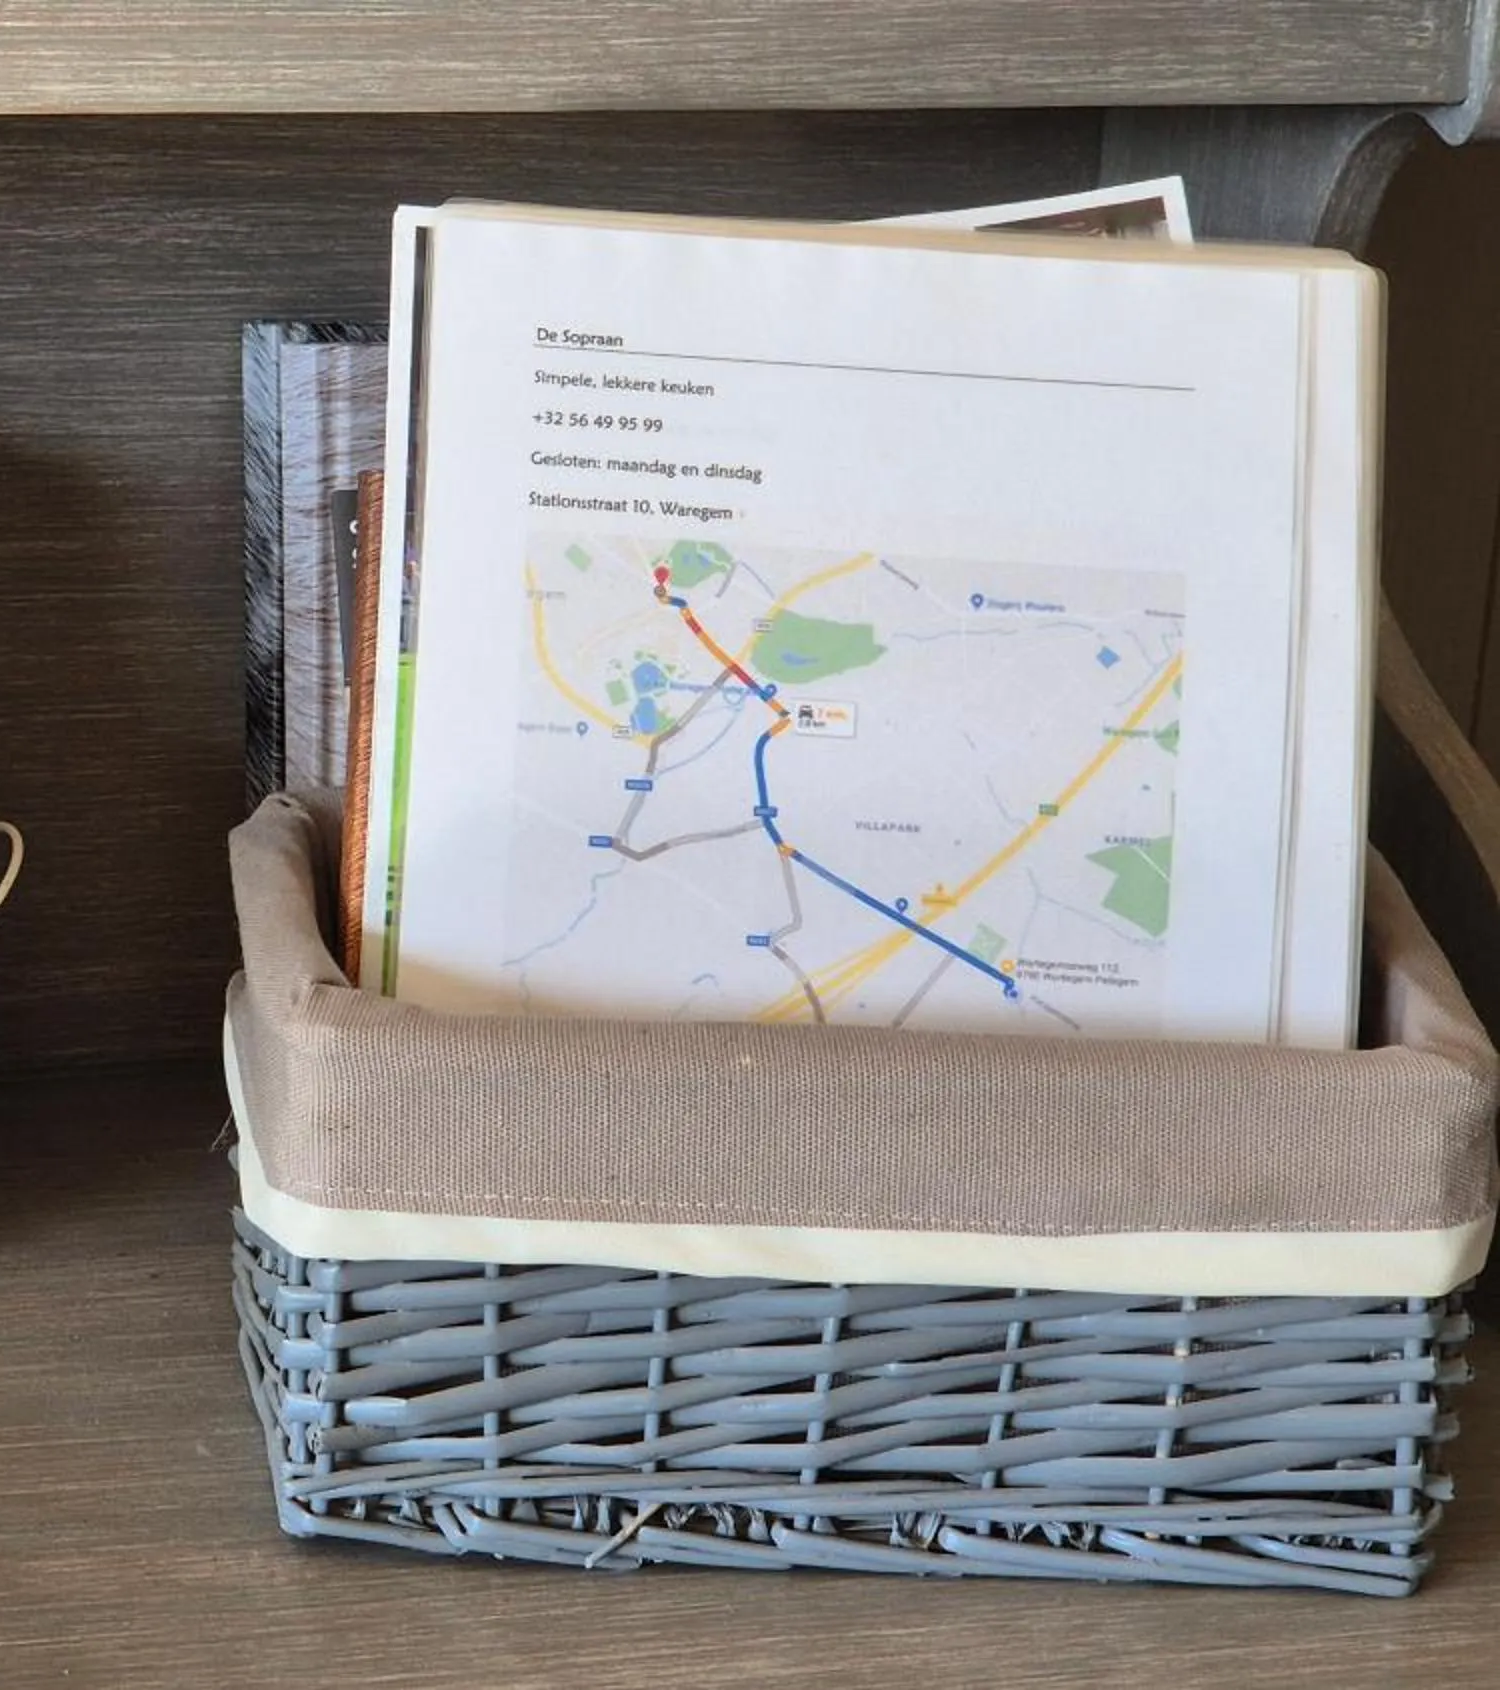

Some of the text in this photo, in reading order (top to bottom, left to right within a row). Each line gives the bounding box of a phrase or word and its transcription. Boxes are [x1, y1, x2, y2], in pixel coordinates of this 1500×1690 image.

[536, 327, 624, 347] De Sopraan
[603, 375, 655, 393] lekkere
[661, 379, 715, 397] keuken
[532, 411, 664, 433] +32 56 49 95 99
[531, 451, 763, 484] Gesloten: maandag en dinsdag
[529, 491, 627, 513] Stationsstraat
[659, 500, 733, 522] Waregem
[855, 820, 921, 833] VILLAPARK
